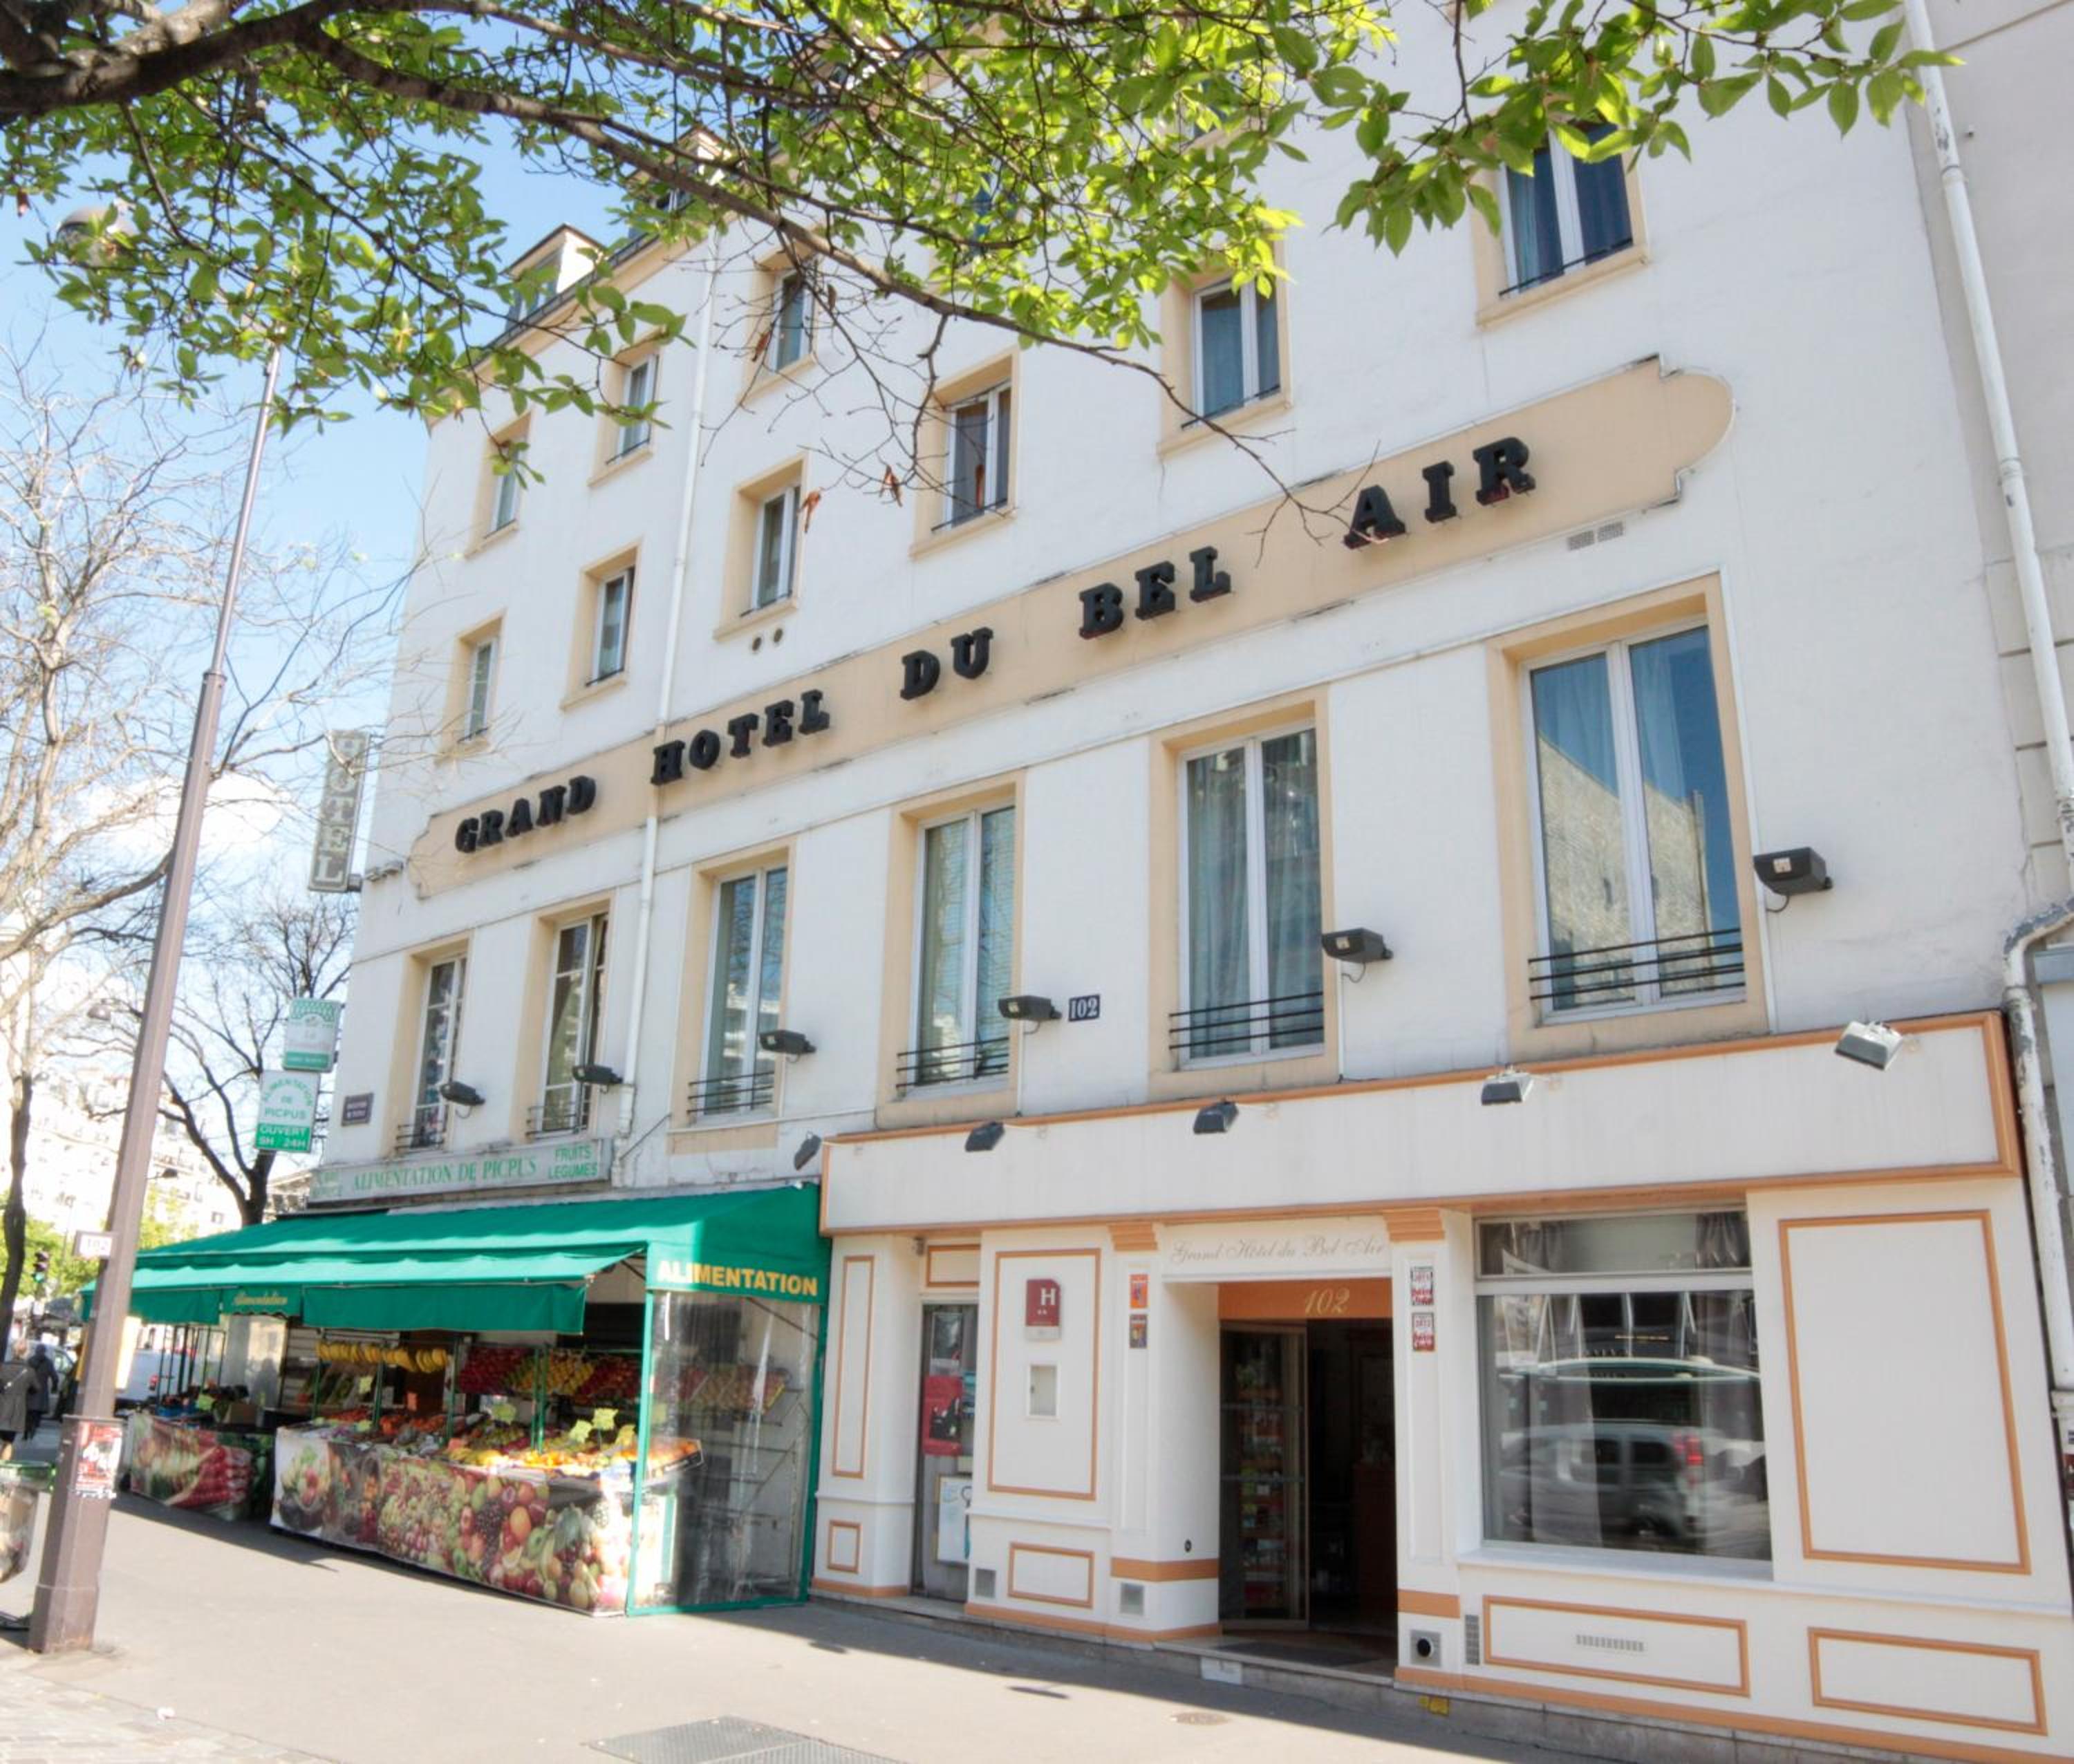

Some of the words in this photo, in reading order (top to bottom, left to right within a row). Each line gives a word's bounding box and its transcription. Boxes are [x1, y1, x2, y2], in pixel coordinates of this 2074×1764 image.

[455, 776, 597, 854] GRAND
[651, 689, 830, 786] HOTEL
[900, 627, 994, 701] DU
[1078, 545, 1231, 640] BEL
[1343, 436, 1536, 550] AIR
[1071, 997, 1098, 1019] 102
[264, 1107, 307, 1120] PICPUS
[259, 1123, 306, 1136] OUVERT
[283, 1138, 306, 1148] 24H
[554, 1144, 592, 1163] FRUITS
[354, 1163, 453, 1190] ALIMENTATION
[458, 1160, 477, 1183] DE
[483, 1156, 537, 1181] PICPUS
[1170, 1239, 1226, 1264] Grand
[1278, 1239, 1296, 1257] du
[1303, 1235, 1340, 1257] Bel
[657, 1260, 818, 1296] ALIMENTATION
[1040, 1288, 1056, 1306] H
[1305, 1287, 1350, 1315] 102
